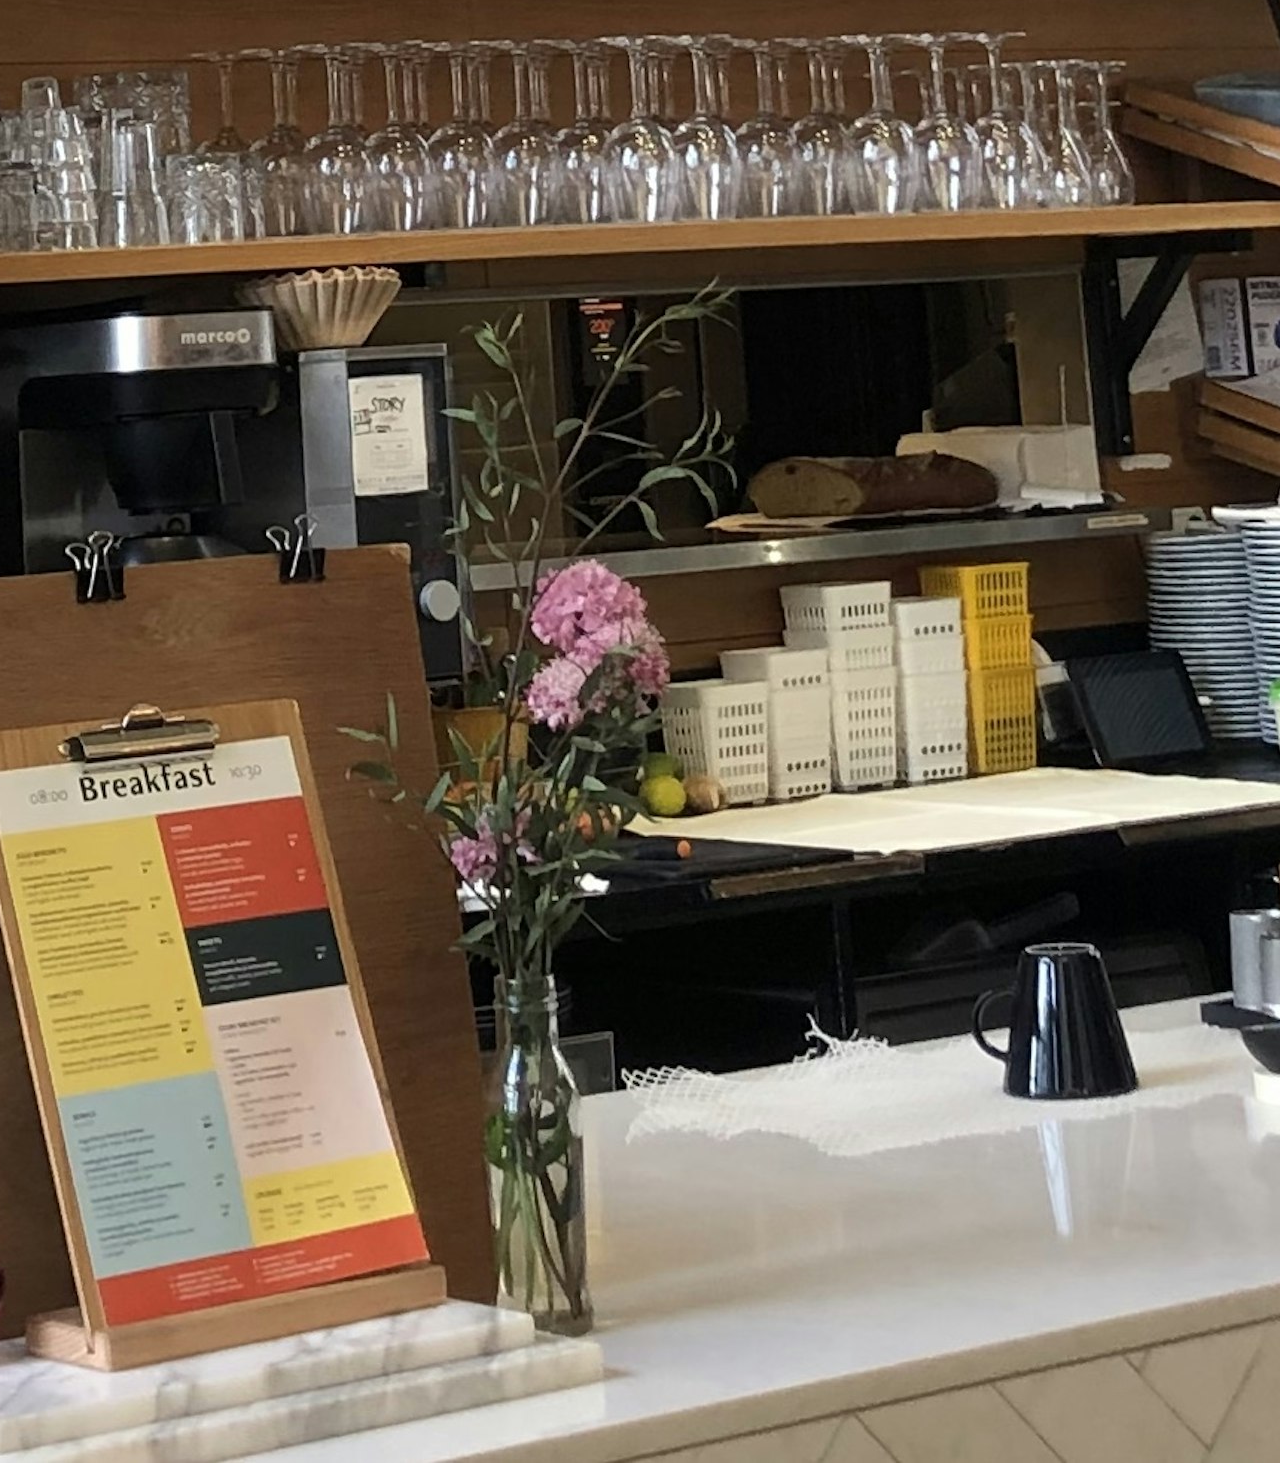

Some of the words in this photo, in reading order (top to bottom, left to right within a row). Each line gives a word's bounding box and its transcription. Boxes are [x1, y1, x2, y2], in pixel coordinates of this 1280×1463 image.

[181, 330, 236, 345] marco
[29, 789, 68, 805] 08:00
[79, 762, 216, 802] Breakfast
